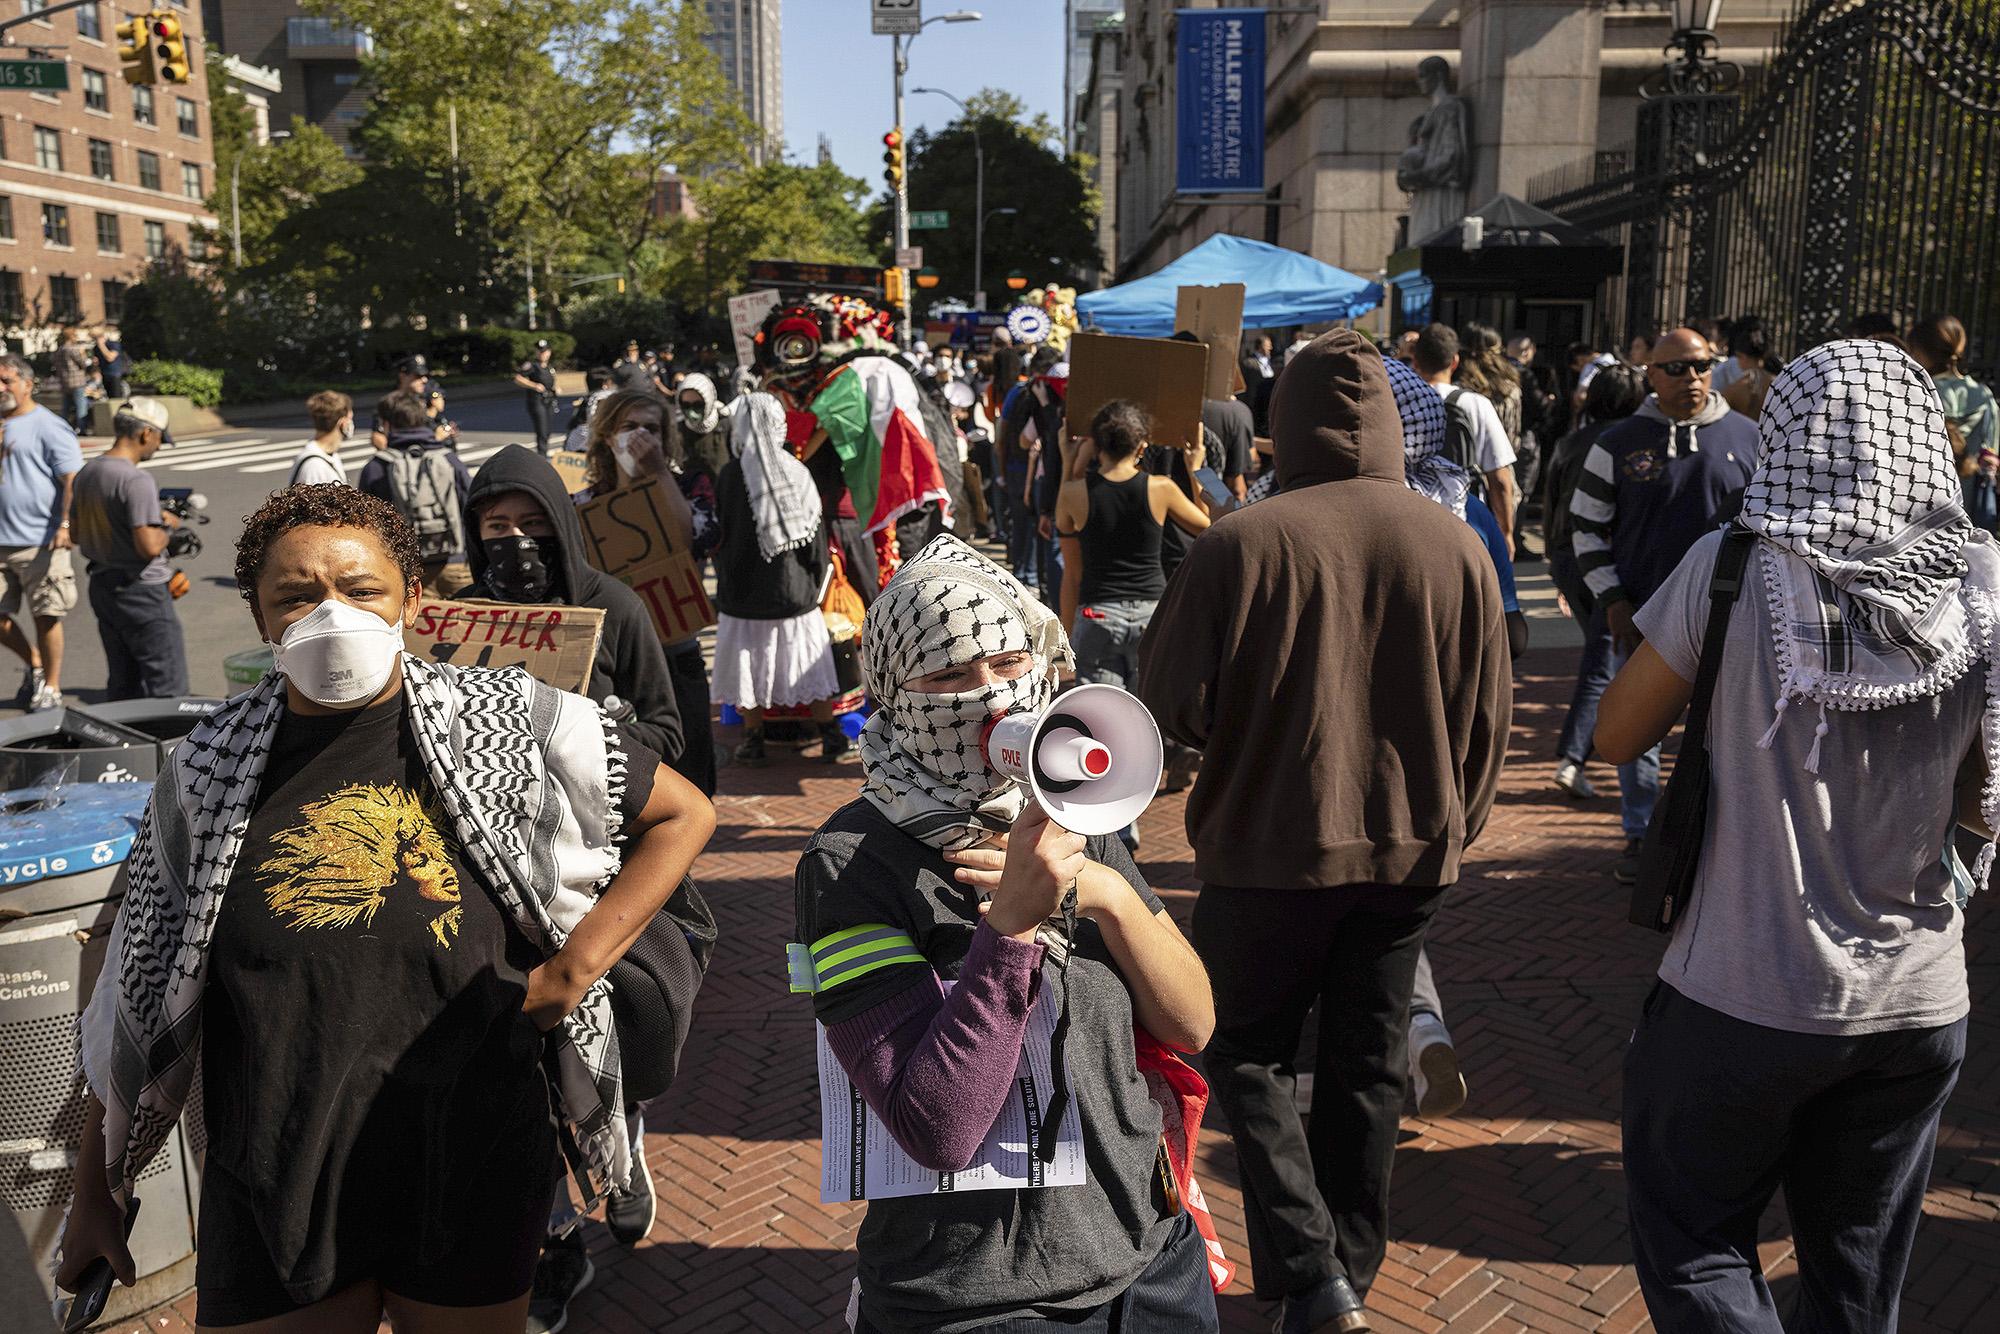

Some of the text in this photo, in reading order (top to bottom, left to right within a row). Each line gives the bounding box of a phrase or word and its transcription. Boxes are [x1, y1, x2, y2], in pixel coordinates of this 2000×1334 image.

[23, 63, 43, 85] St
[1210, 19, 1225, 180] COLUMBIA UNIVERSITY
[415, 605, 562, 652] SETTLER
[329, 669, 353, 682] 3M
[1001, 748, 1022, 768] PYLE
[0, 857, 68, 882] ycle
[0, 979, 71, 1000] Cartons
[855, 1100, 863, 1125] SHAME.
[1028, 1110, 1037, 1126] ONE
[1031, 1128, 1039, 1149] ONLY
[854, 1164, 862, 1197] COLUMBIA
[1032, 1161, 1041, 1187] THERE
